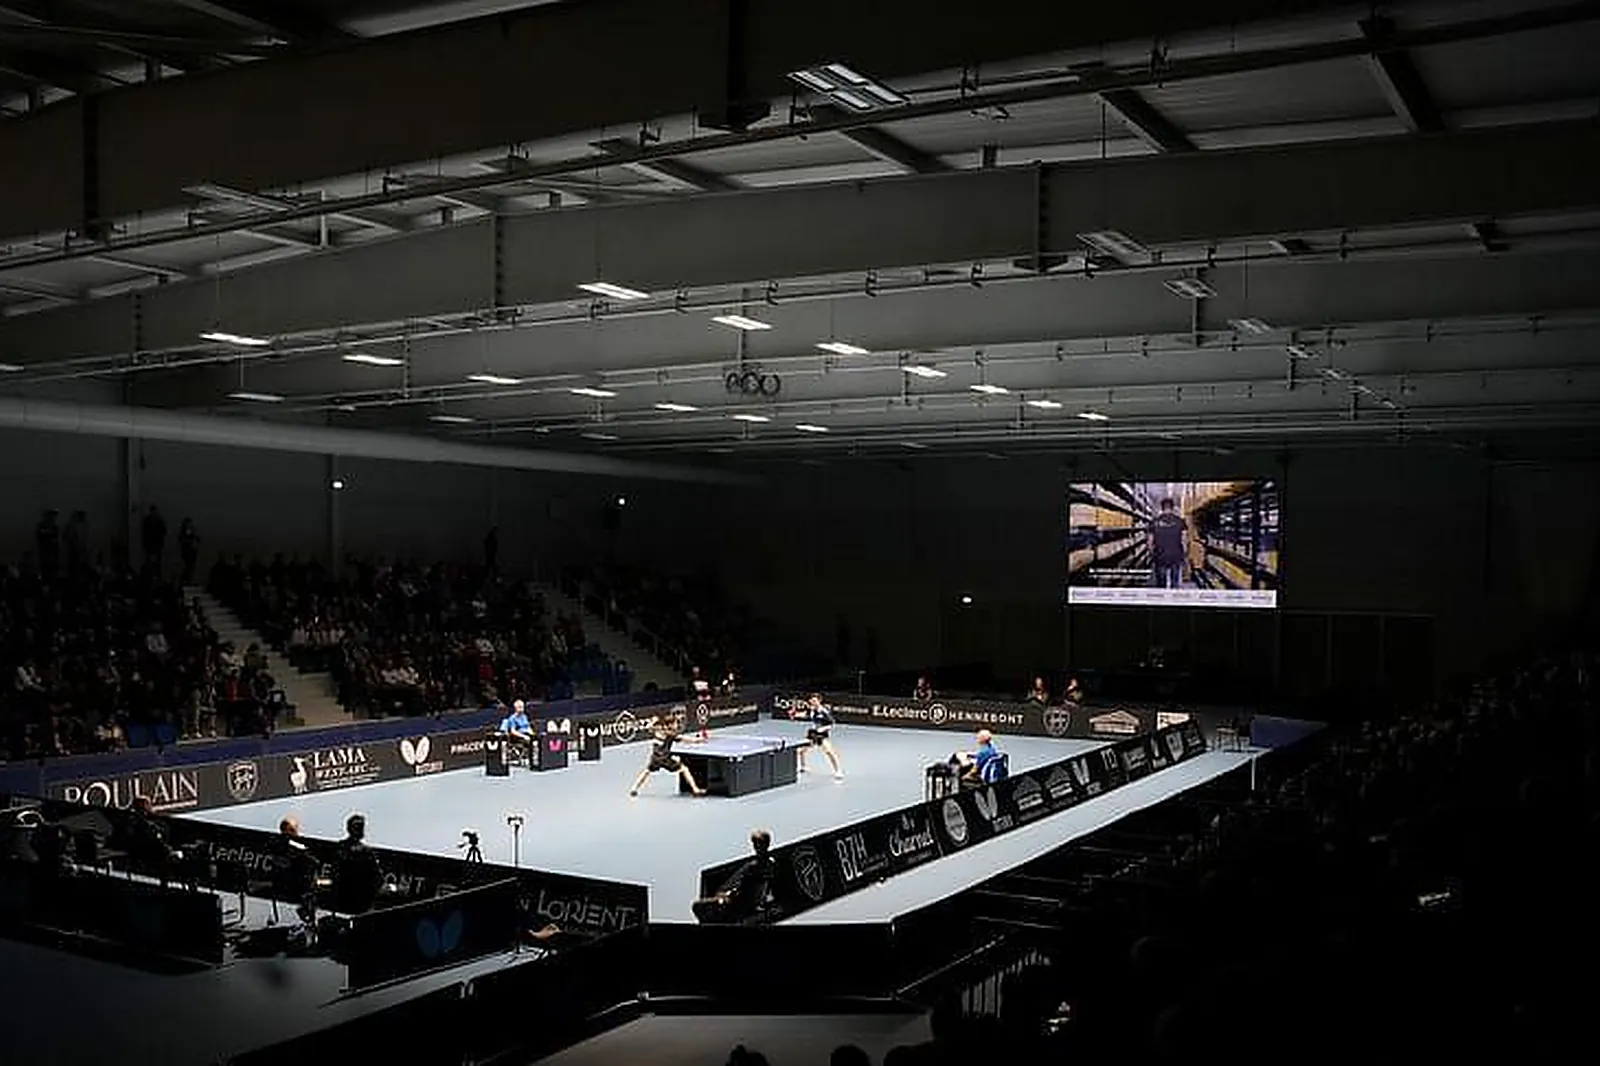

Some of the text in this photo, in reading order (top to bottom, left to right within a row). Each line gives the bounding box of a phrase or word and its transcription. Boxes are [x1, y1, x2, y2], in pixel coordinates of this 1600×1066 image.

[949, 710, 1024, 725] HENNEBONT
[314, 747, 366, 769] LAMA
[836, 831, 868, 881] BZH
